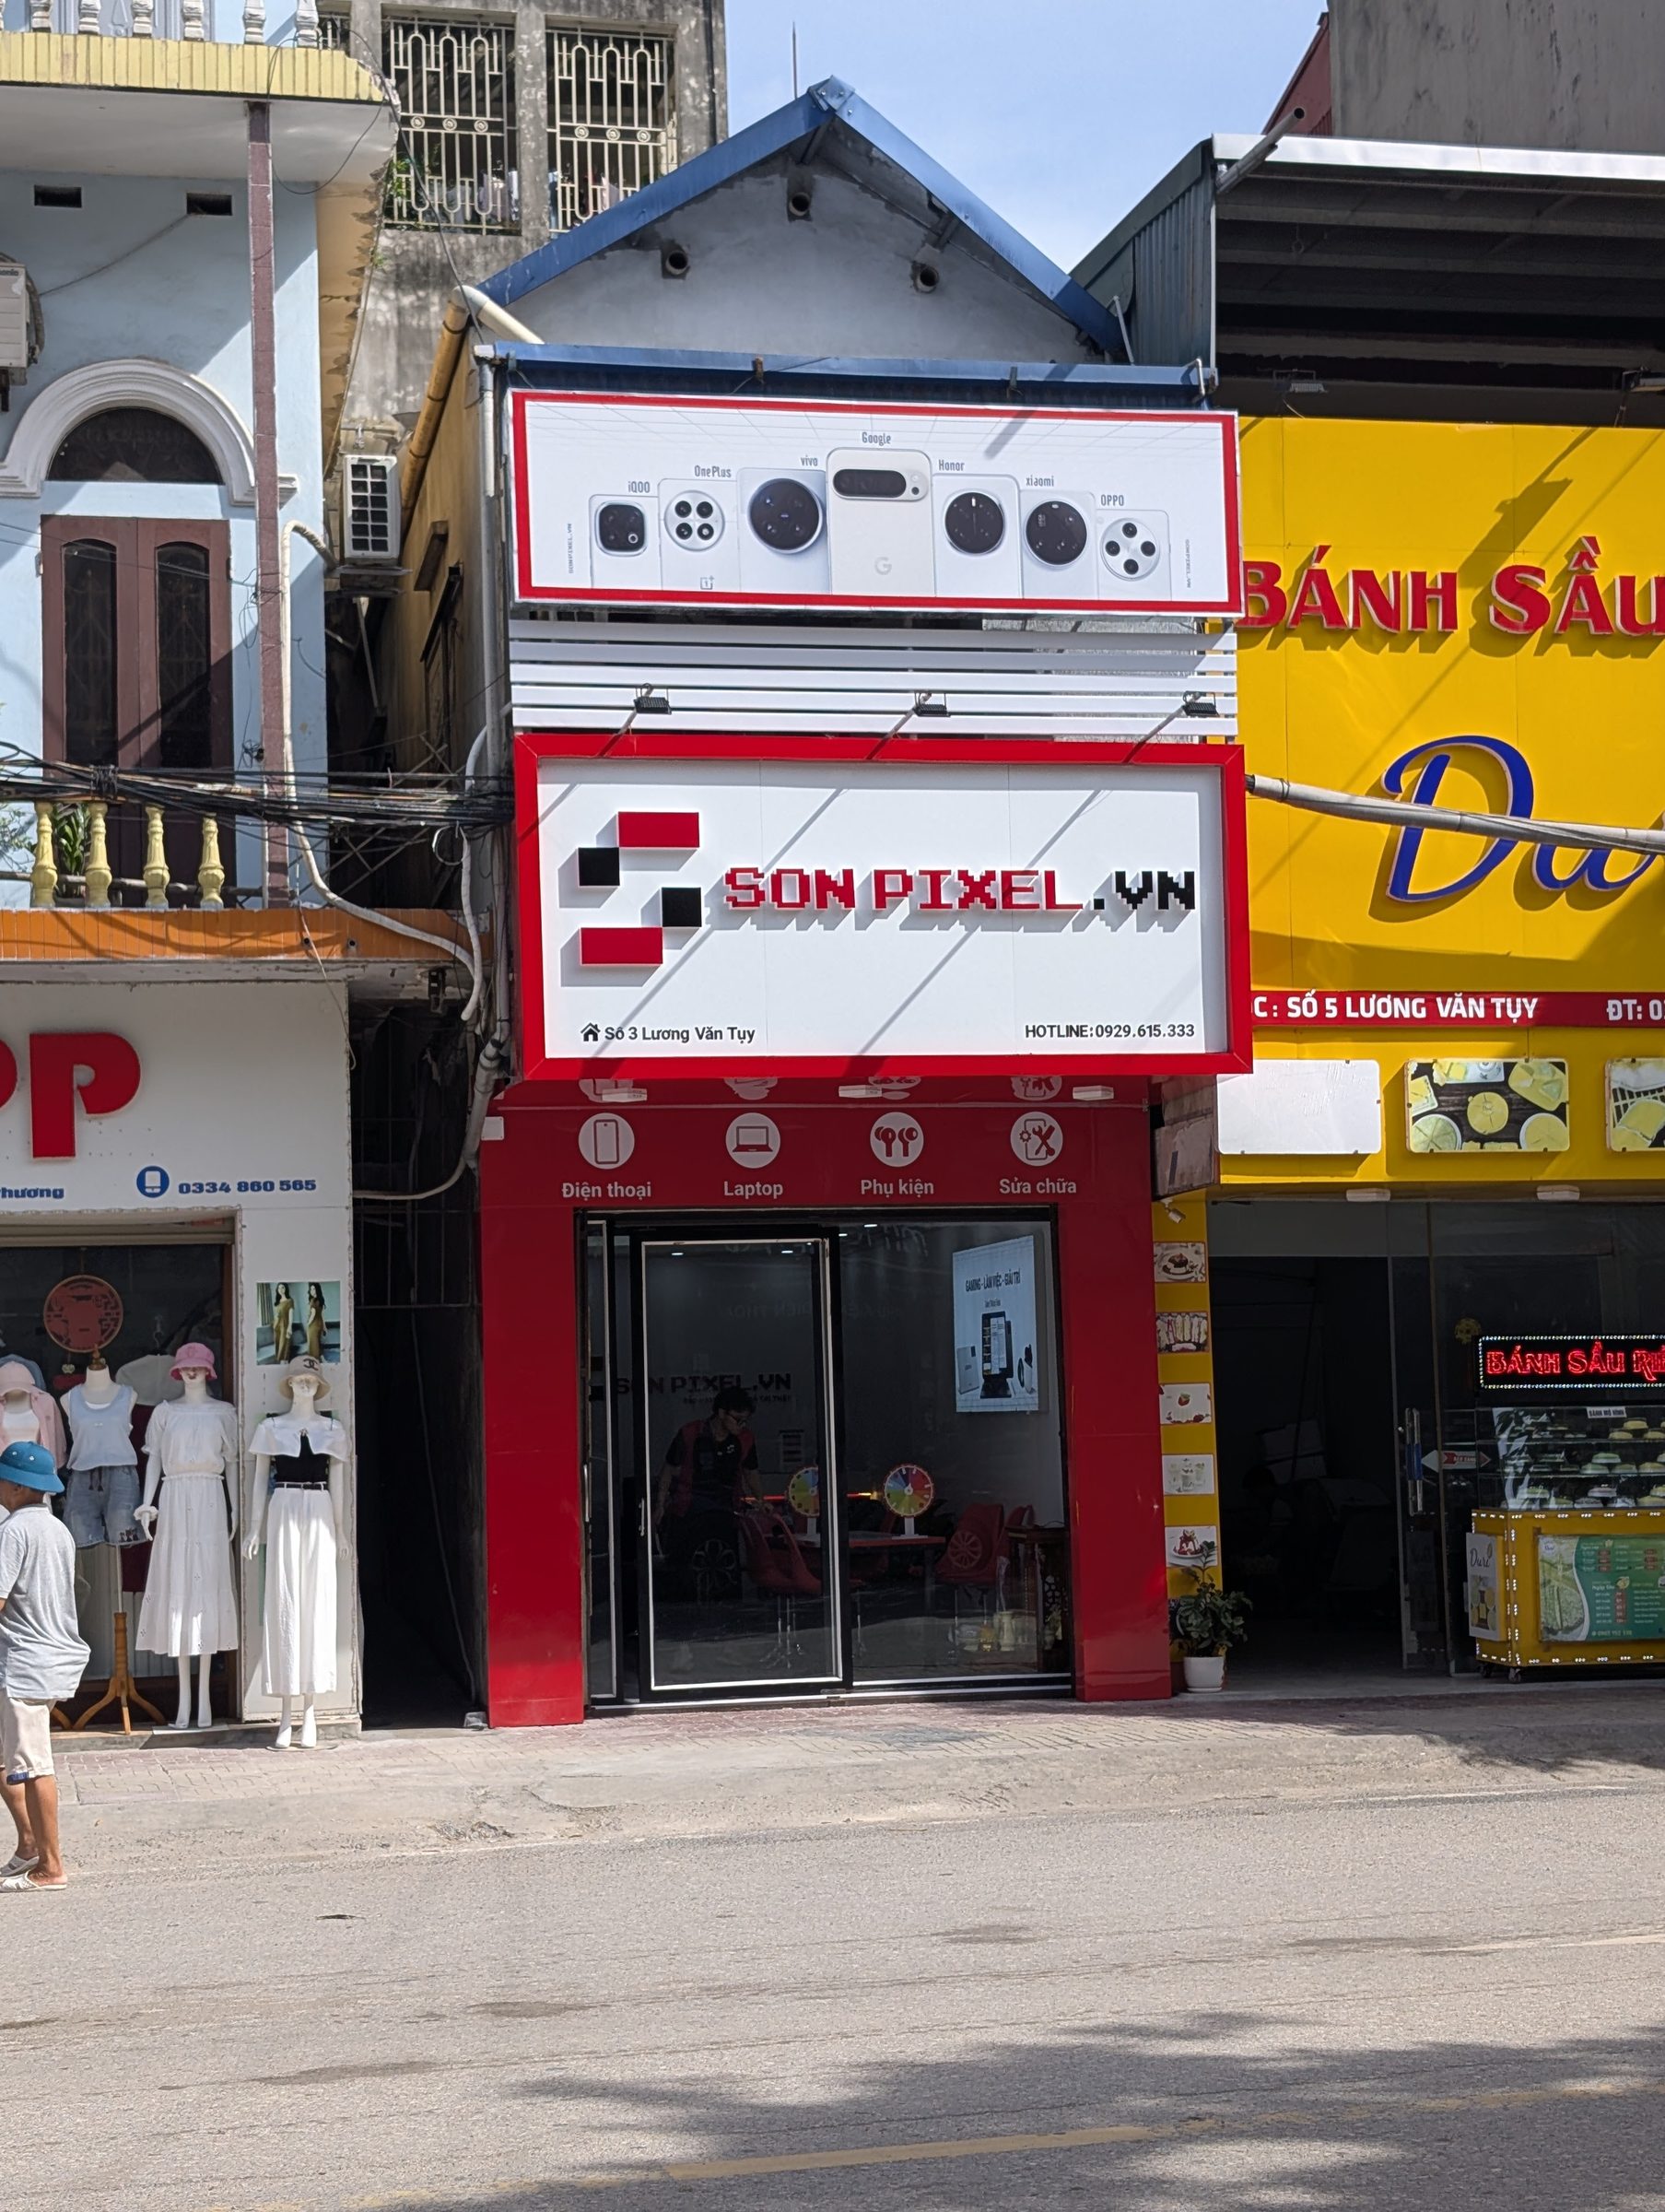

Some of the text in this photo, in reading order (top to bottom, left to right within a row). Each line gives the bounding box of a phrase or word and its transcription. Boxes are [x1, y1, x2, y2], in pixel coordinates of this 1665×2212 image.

[862, 430, 891, 446] Google
[801, 455, 818, 466] vivo
[939, 459, 965, 471] Honor
[695, 465, 732, 478] OnePlus
[627, 481, 651, 493] iQOO
[1026, 475, 1054, 488] xiaomi
[1101, 494, 1124, 506] OPPO
[1237, 545, 1459, 632] BÁNH
[723, 866, 1196, 911] SON PIXEL.VN
[1287, 988, 1319, 1018] SỐ
[1325, 997, 1338, 1018] 5
[1346, 994, 1426, 1018] LƯƠNG
[1436, 992, 1487, 1018] VĂN
[1489, 995, 1539, 1023] TỤY
[1606, 999, 1665, 1021] ĐT: 0
[628, 1026, 638, 1041] 3
[642, 1027, 690, 1043] Lương
[695, 1026, 723, 1041] Văn
[727, 1027, 756, 1044] Tụy
[0, 1187, 64, 1199] hương
[178, 1180, 316, 1194] 0334 860 565
[561, 1181, 651, 1201] Điện thoại
[724, 1181, 783, 1199] Laptop
[861, 1179, 934, 1198] Phụ kiện
[999, 1177, 1077, 1194] Sửa chữa
[1486, 1345, 1562, 1374] BÁNH
